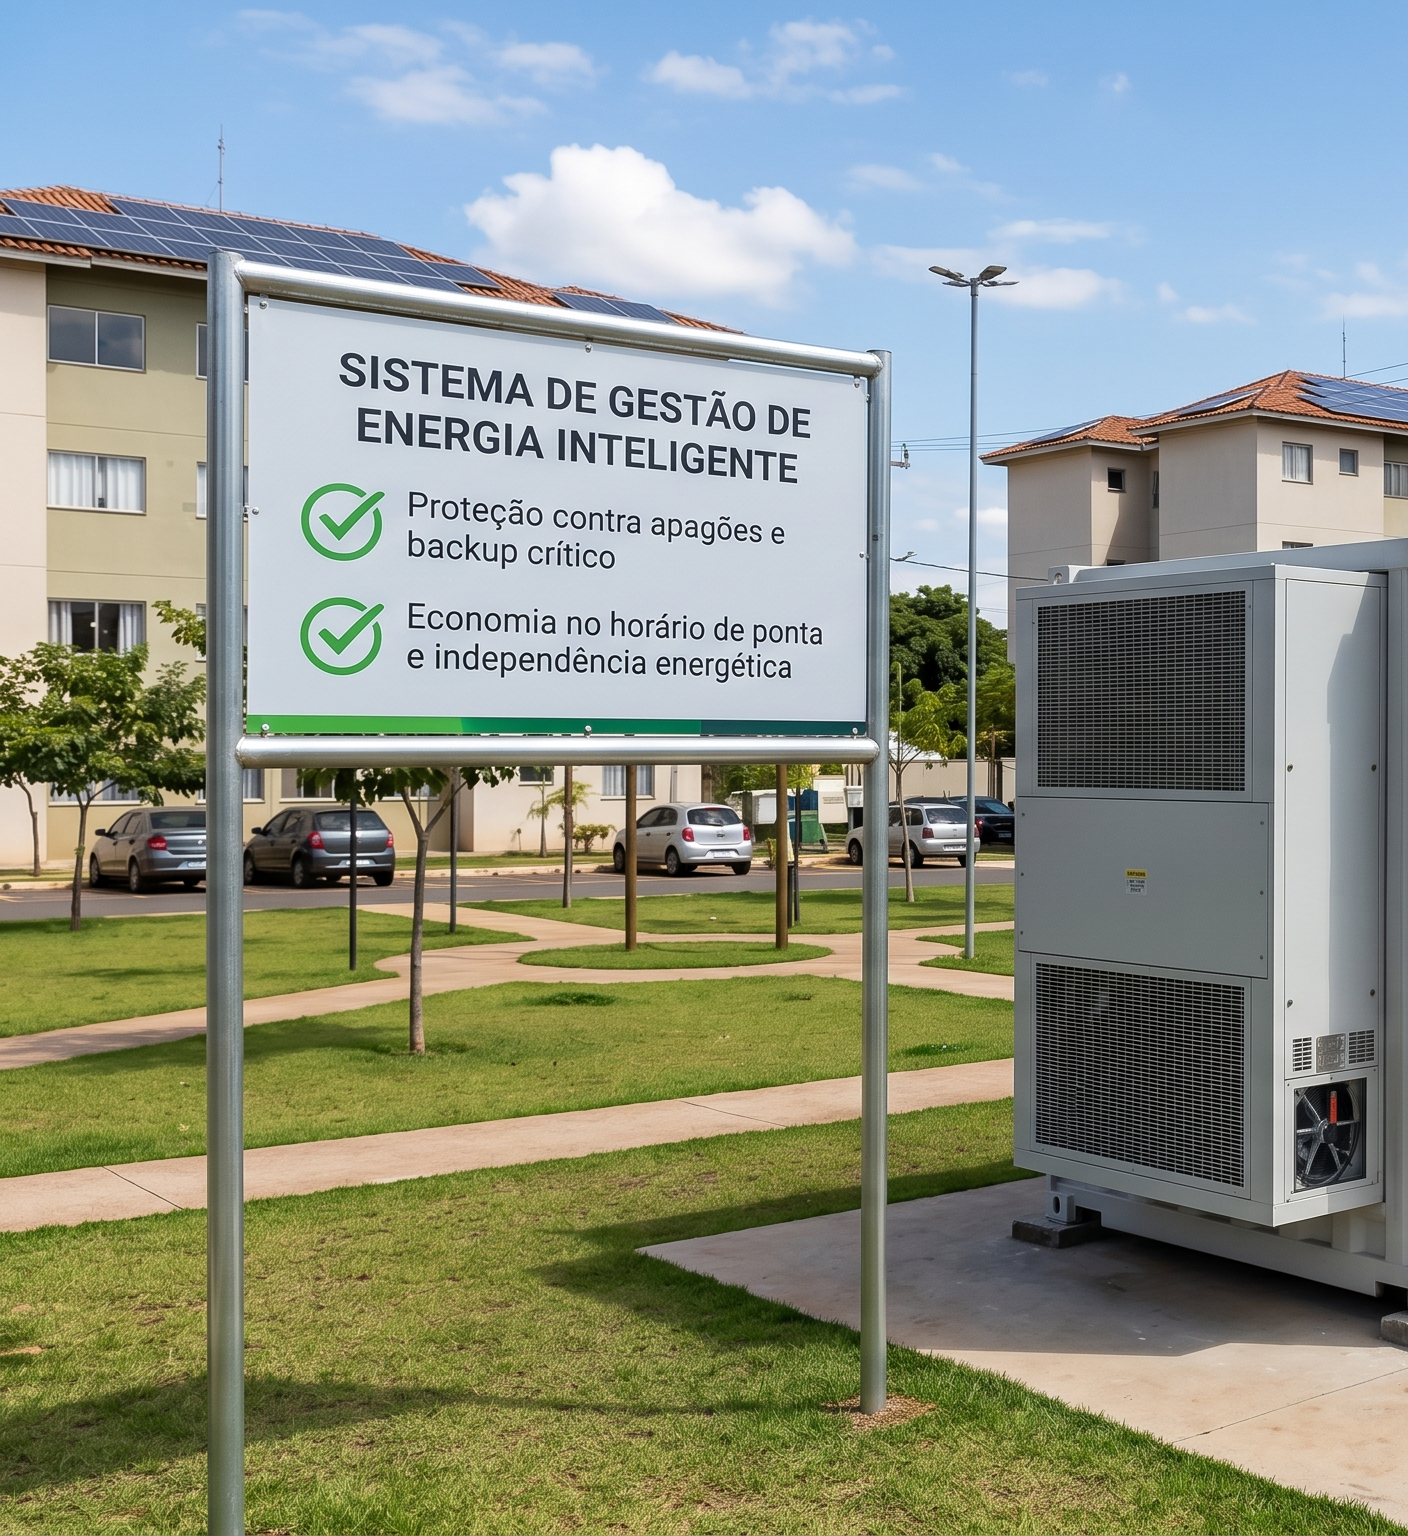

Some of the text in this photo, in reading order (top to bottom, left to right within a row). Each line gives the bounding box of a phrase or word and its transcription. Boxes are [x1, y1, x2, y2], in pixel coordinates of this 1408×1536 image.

[338, 352, 811, 439] SISTEMA DE GESTÃO DE
[357, 407, 798, 484] ENERGIA INTELIGENTE
[408, 491, 785, 546] Proteção contra apagões e
[408, 529, 616, 571] backup crítico
[408, 602, 823, 649] Economia no horário de ponta
[407, 642, 792, 684] e independência energética
